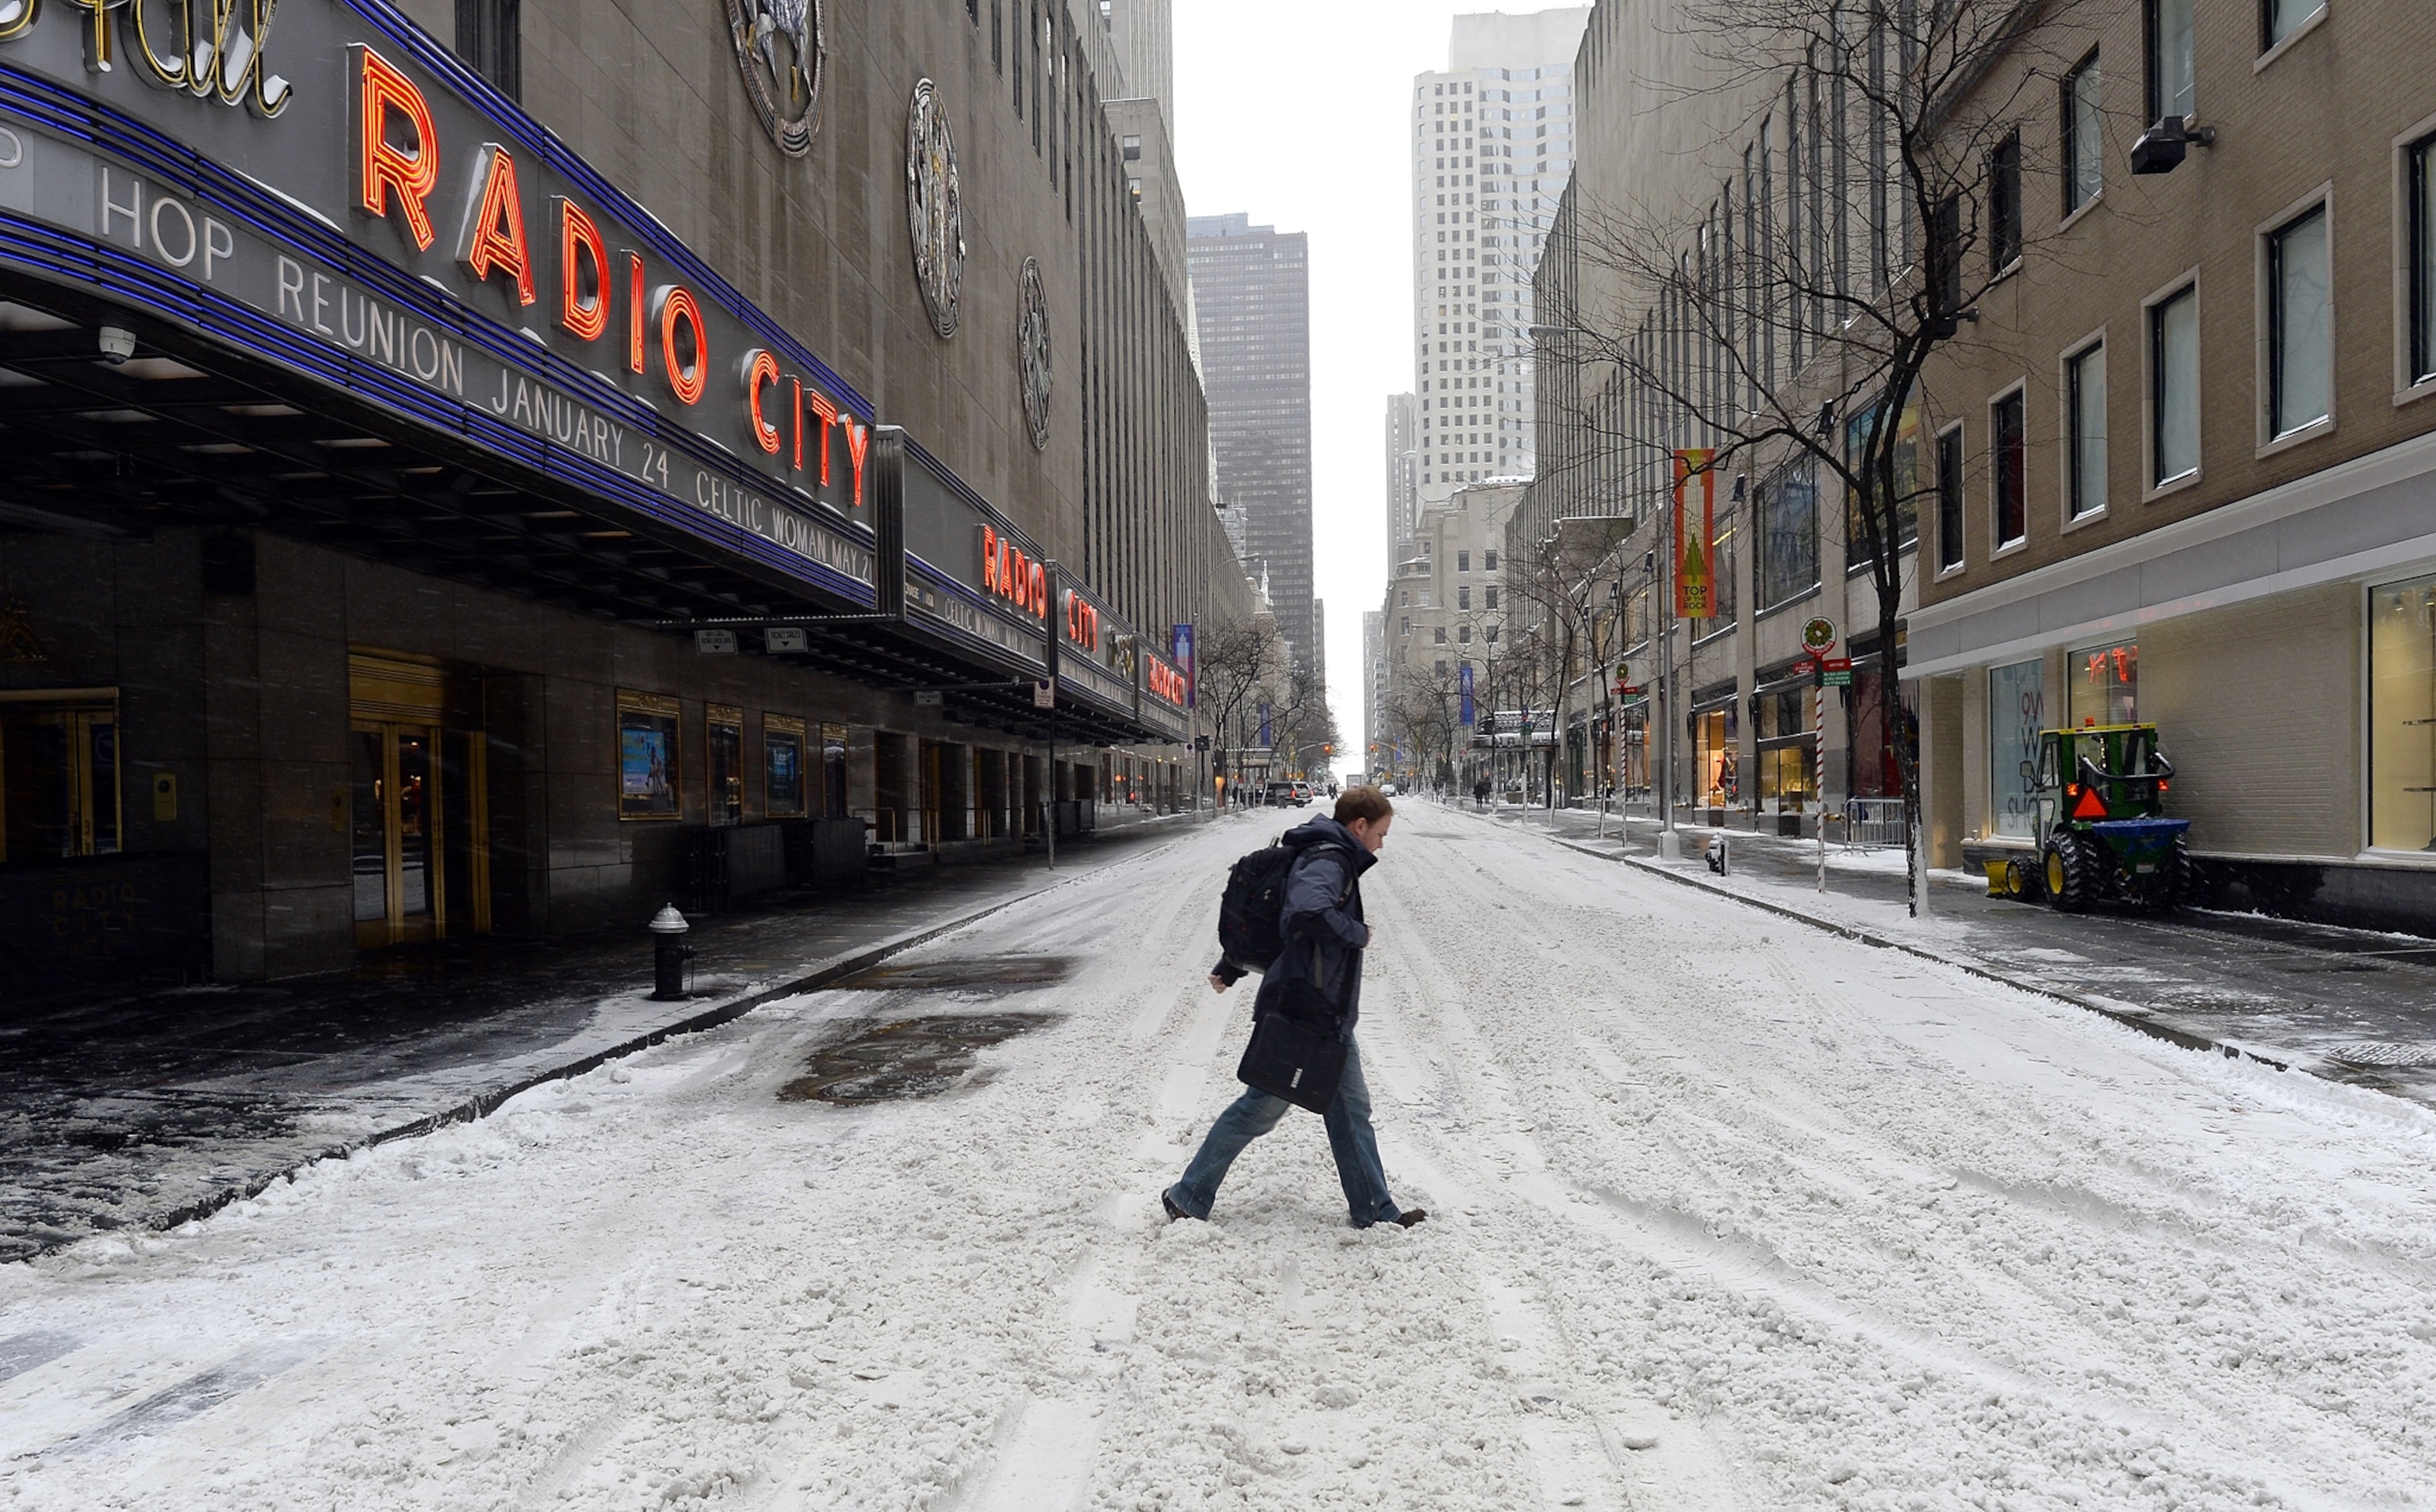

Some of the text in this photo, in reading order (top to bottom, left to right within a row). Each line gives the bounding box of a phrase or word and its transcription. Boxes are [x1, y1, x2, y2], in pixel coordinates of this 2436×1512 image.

[353, 44, 868, 507] RADIO CITY
[100, 166, 234, 281] HOP
[277, 254, 464, 396] REUNION
[490, 369, 624, 468] JANUARY
[642, 442, 669, 490] 24
[696, 470, 763, 532] CELTIC
[772, 515, 827, 565] WOMAN
[831, 538, 857, 576] MAY
[862, 554, 873, 583] 21
[981, 524, 1046, 620] RADIO
[1067, 588, 1098, 653] CITY
[1682, 585, 1707, 595] TOP
[944, 597, 971, 631] CELTIC
[975, 612, 1000, 643] WOMAN
[52, 881, 136, 913] RADIO
[52, 906, 138, 939] CITY
[1291, 1068, 1303, 1089] THULE
